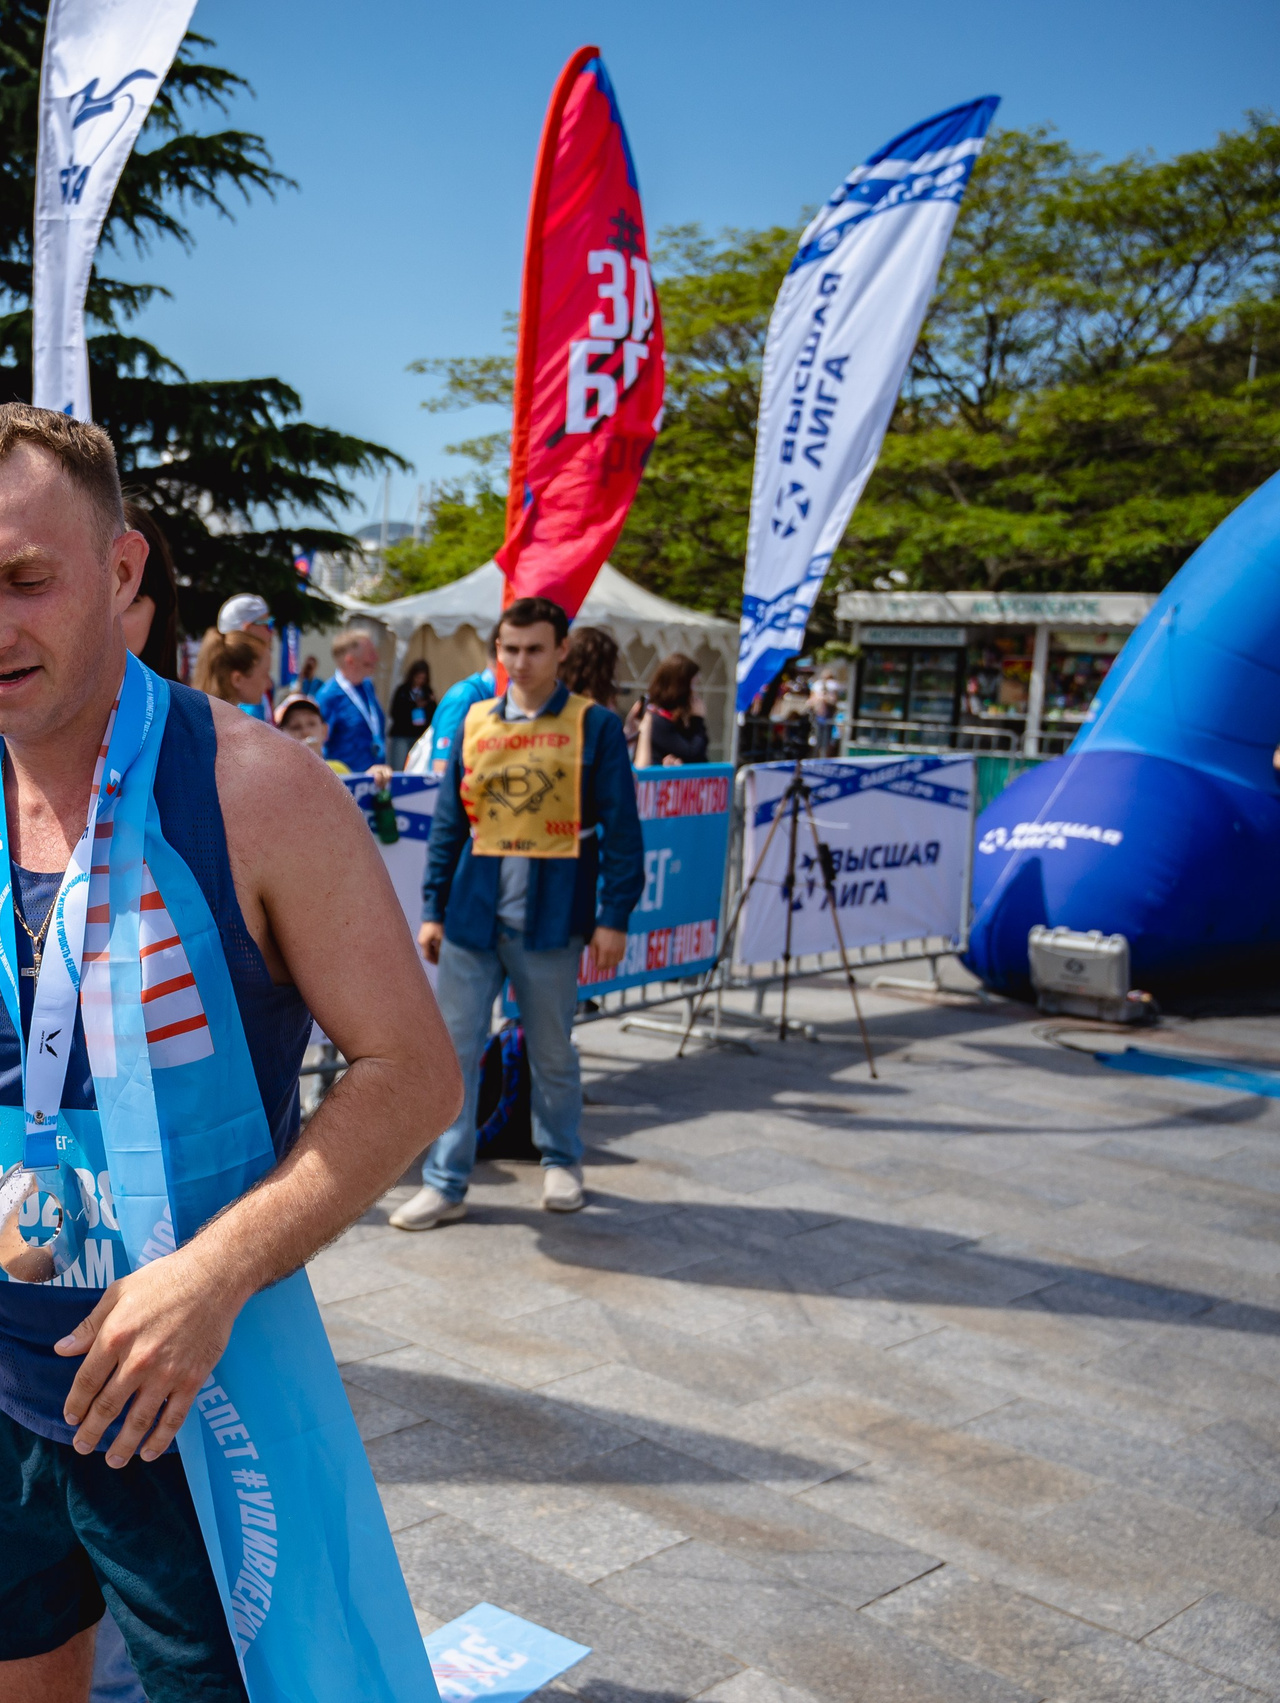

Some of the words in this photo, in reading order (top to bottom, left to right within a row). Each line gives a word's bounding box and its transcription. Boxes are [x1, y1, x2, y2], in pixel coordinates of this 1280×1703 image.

[780, 272, 843, 464] ВЫСШАЯ
[803, 354, 851, 470] ЛИГА
[476, 734, 571, 754] ВОЛОНТЕР
[55, 919, 71, 958] #ГОРДОСТЬ
